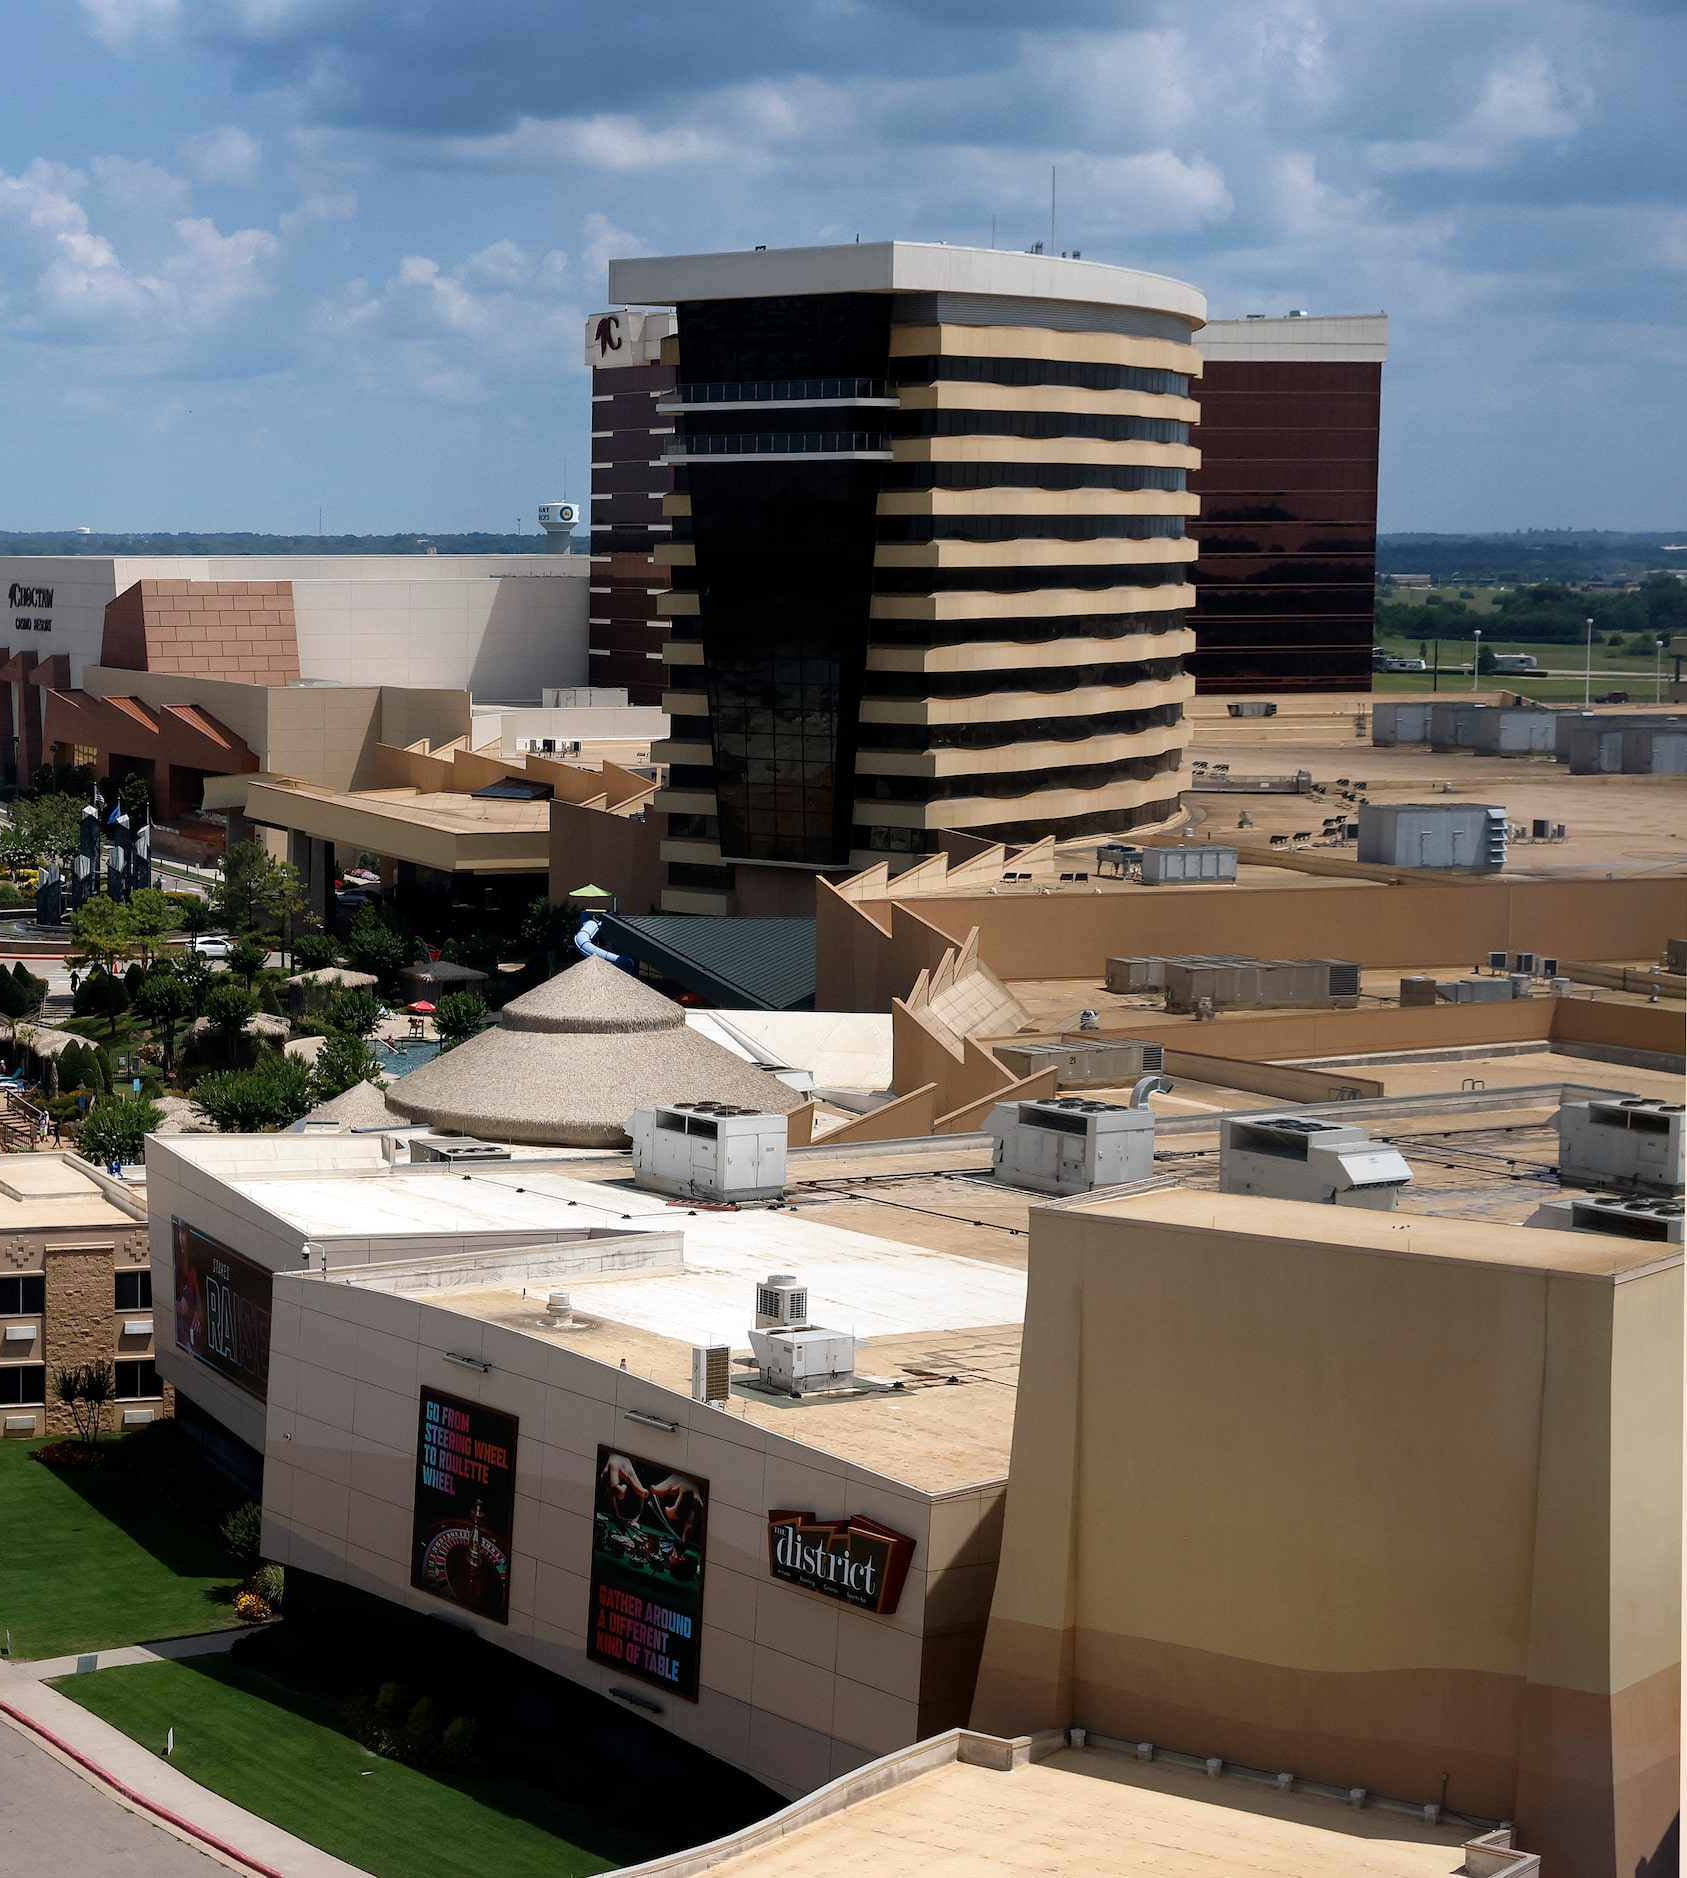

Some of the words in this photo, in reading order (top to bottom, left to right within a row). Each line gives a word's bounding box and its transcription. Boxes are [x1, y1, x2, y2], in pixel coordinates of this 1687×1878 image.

[426, 1400, 440, 1423] GO
[441, 1406, 470, 1433] FROM
[424, 1443, 437, 1466] TO
[439, 1449, 490, 1485] ROULETTE
[425, 1422, 473, 1457] STEERING
[474, 1439, 509, 1470] WHEEL
[422, 1465, 456, 1495] WHEEL
[773, 1526, 787, 1537] THE
[776, 1525, 876, 1596] district
[597, 1607, 606, 1629] A
[609, 1611, 669, 1654] DIFFERENT
[599, 1584, 643, 1619] GATHER
[645, 1602, 692, 1639] AROUND
[596, 1630, 624, 1659] KIND
[626, 1642, 641, 1665] OF
[643, 1648, 680, 1682] TABLE
